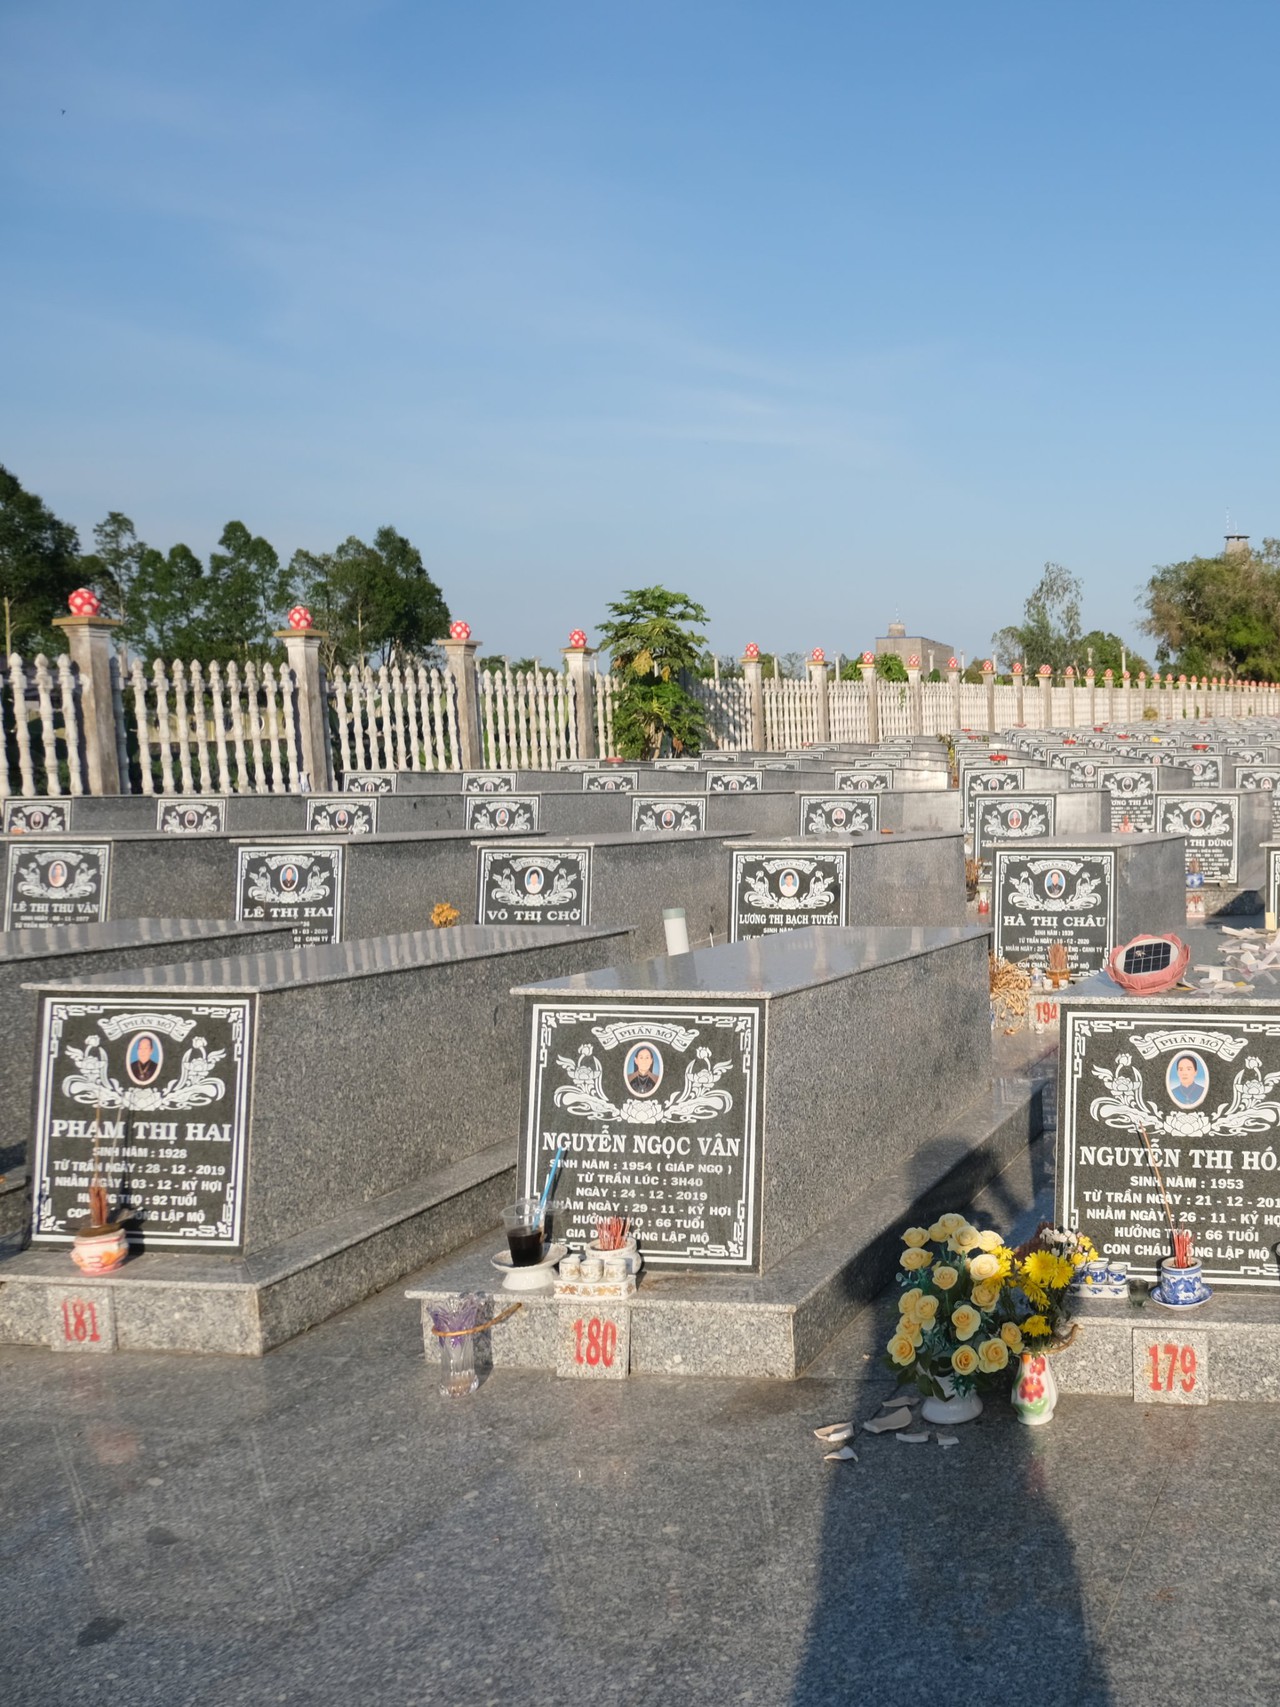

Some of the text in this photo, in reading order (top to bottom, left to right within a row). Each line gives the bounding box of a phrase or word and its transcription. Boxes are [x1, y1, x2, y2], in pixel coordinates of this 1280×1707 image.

[29, 903, 50, 915] THỊ
[51, 903, 75, 913] THU
[243, 905, 334, 920] LÊ THỊ HAI
[513, 911, 542, 923] THỊ
[768, 914, 784, 926] THỊ
[785, 914, 809, 927] BẠCH
[1003, 913, 1107, 928] HÀ THỊ CHÂU
[51, 1119, 232, 1145] PHẠM THỊ HAI
[542, 1125, 741, 1159] NGUYỄN NGỌC VÂN
[92, 1145, 188, 1159] SINH NĂM 1928
[1079, 1138, 1180, 1168] NGUYỄN
[1188, 1150, 1234, 1174] THỊ
[145, 1163, 161, 1174] 28
[171, 1164, 186, 1175] 12
[195, 1164, 226, 1176] 2019
[549, 1158, 723, 1175] SINH NĂM 1954 GIÁP NGỌ
[131, 1178, 147, 1189] 03
[157, 1179, 172, 1190] 12
[577, 1171, 595, 1183] TỪ
[634, 1174, 660, 1185] LÚC
[670, 1177, 704, 1187] 3H40
[1130, 1175, 1244, 1190] SINH NĂM 1953
[152, 1195, 168, 1206] 92
[576, 1185, 708, 1201] NGÀY 24 12 2019
[1083, 1189, 1103, 1202] TỪ
[1105, 1188, 1142, 1204] TRẦN
[1146, 1191, 1182, 1205] NGÀY
[1194, 1195, 1212, 1206] 21
[1226, 1196, 1244, 1207] 12
[161, 1208, 185, 1223] LẬP
[186, 1209, 206, 1224] MỘ
[587, 1200, 621, 1212] NGÀY
[632, 1203, 648, 1213] 29
[660, 1204, 675, 1214] 11
[709, 1205, 732, 1218] HỢI
[1086, 1204, 1126, 1220] NHẰM
[1130, 1208, 1167, 1222] NGÀY
[1178, 1211, 1197, 1223] 26
[1210, 1212, 1227, 1224] 11
[1240, 1210, 1259, 1225] KỶ
[655, 1218, 672, 1228] 66
[675, 1216, 705, 1229] TUỔI
[566, 1228, 586, 1238] GIA
[661, 1230, 687, 1244] LẬP
[690, 1232, 710, 1245] MỘ
[1114, 1224, 1259, 1242] HƯỞNG 66 TUỔI
[1103, 1243, 1131, 1255] CON
[1134, 1242, 1171, 1256] CHÁU
[1217, 1245, 1245, 1261] LẬP
[1248, 1246, 1270, 1262] MỘ
[61, 1299, 100, 1343] 181
[573, 1317, 617, 1369] 180
[1148, 1343, 1197, 1394] 179
